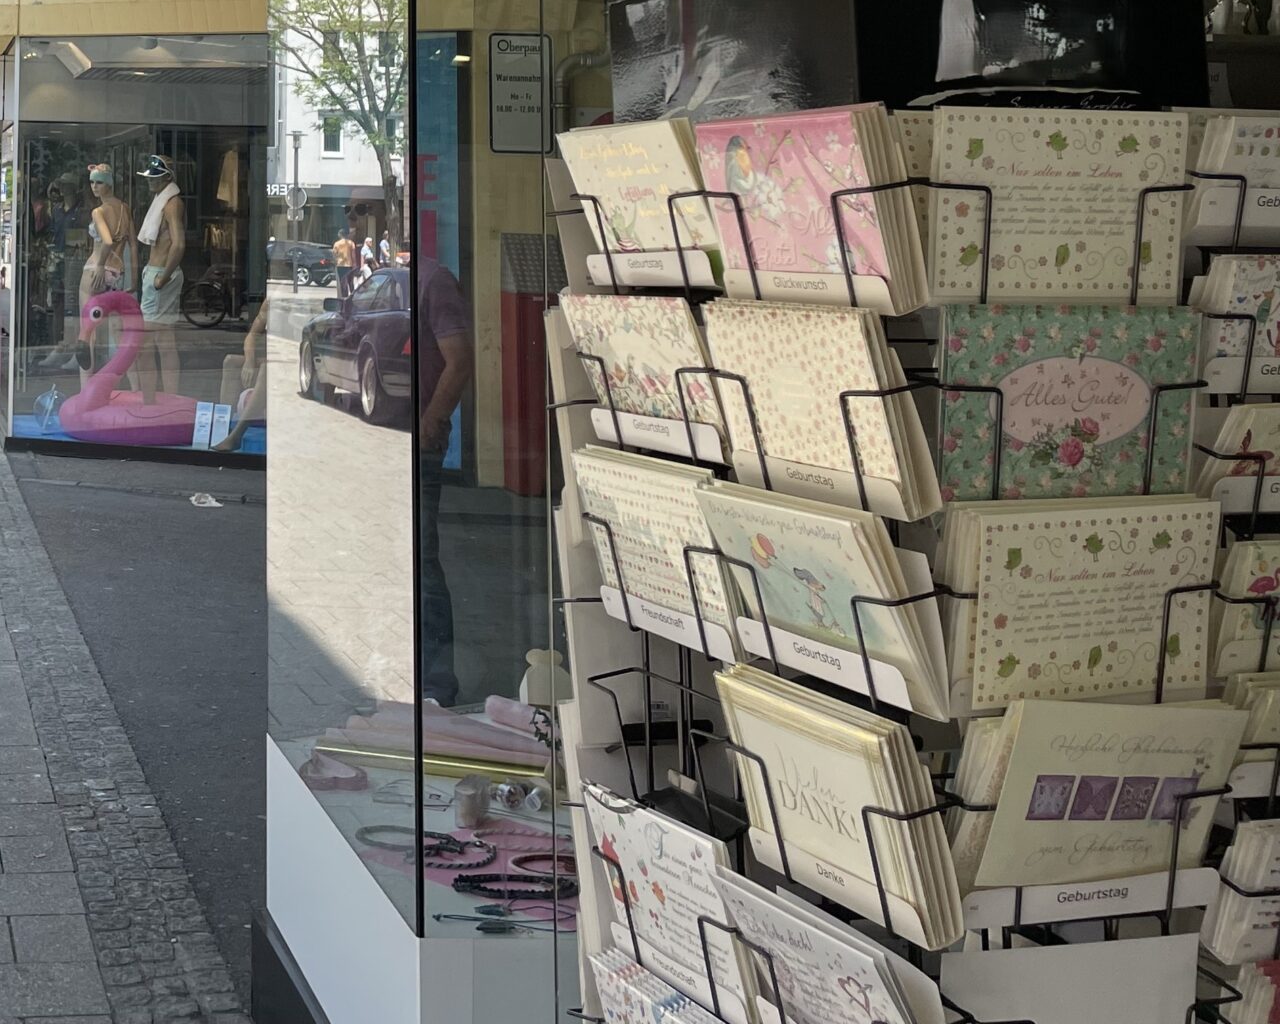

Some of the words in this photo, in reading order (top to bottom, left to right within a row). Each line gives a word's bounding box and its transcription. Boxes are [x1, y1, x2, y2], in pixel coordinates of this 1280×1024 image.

[497, 39, 541, 57] Oberpau
[496, 73, 541, 83] Warenannahm
[772, 275, 829, 291] Glückwunsch
[1010, 380, 1066, 408] Alles
[786, 466, 835, 489] Geburtstag
[792, 640, 842, 671] Geburtstag
[776, 778, 862, 844] DANK!
[815, 862, 846, 888] Danke
[1056, 886, 1129, 904] Geburtstag
